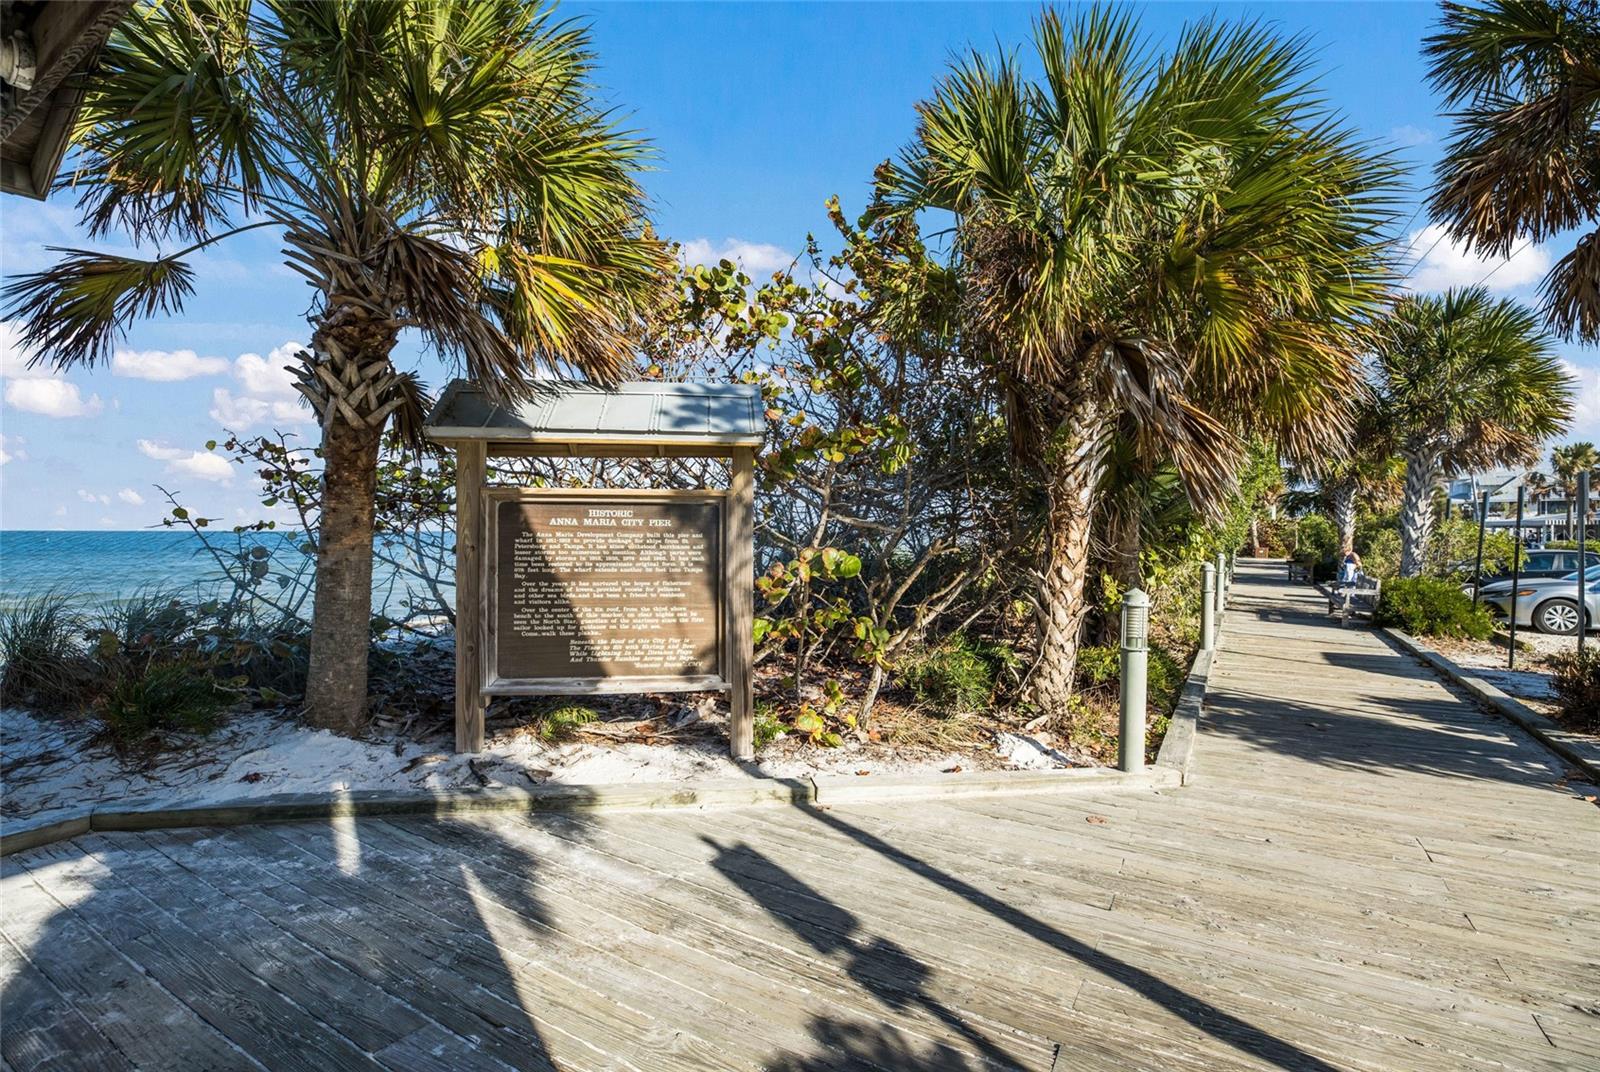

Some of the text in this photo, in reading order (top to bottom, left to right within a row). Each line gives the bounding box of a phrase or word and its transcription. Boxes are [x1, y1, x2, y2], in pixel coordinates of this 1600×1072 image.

[550, 518, 671, 527] ANNA MARIA CITY PIER
